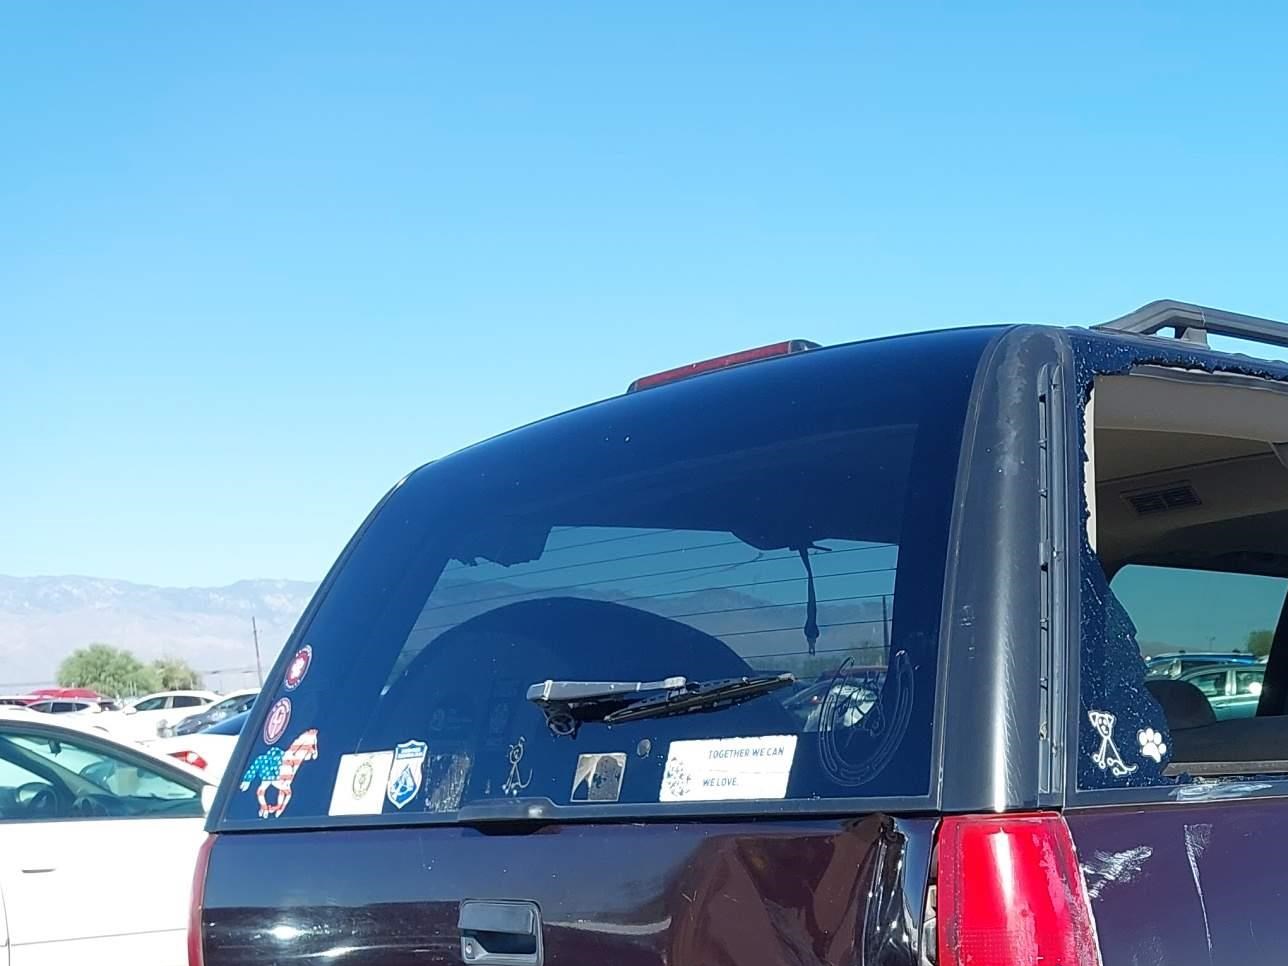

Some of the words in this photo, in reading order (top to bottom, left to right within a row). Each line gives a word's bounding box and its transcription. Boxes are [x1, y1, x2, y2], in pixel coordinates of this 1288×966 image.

[708, 748, 750, 760] TOGETHER
[752, 747, 766, 757] WE
[766, 746, 785, 757] CAN
[703, 777, 715, 787] WE
